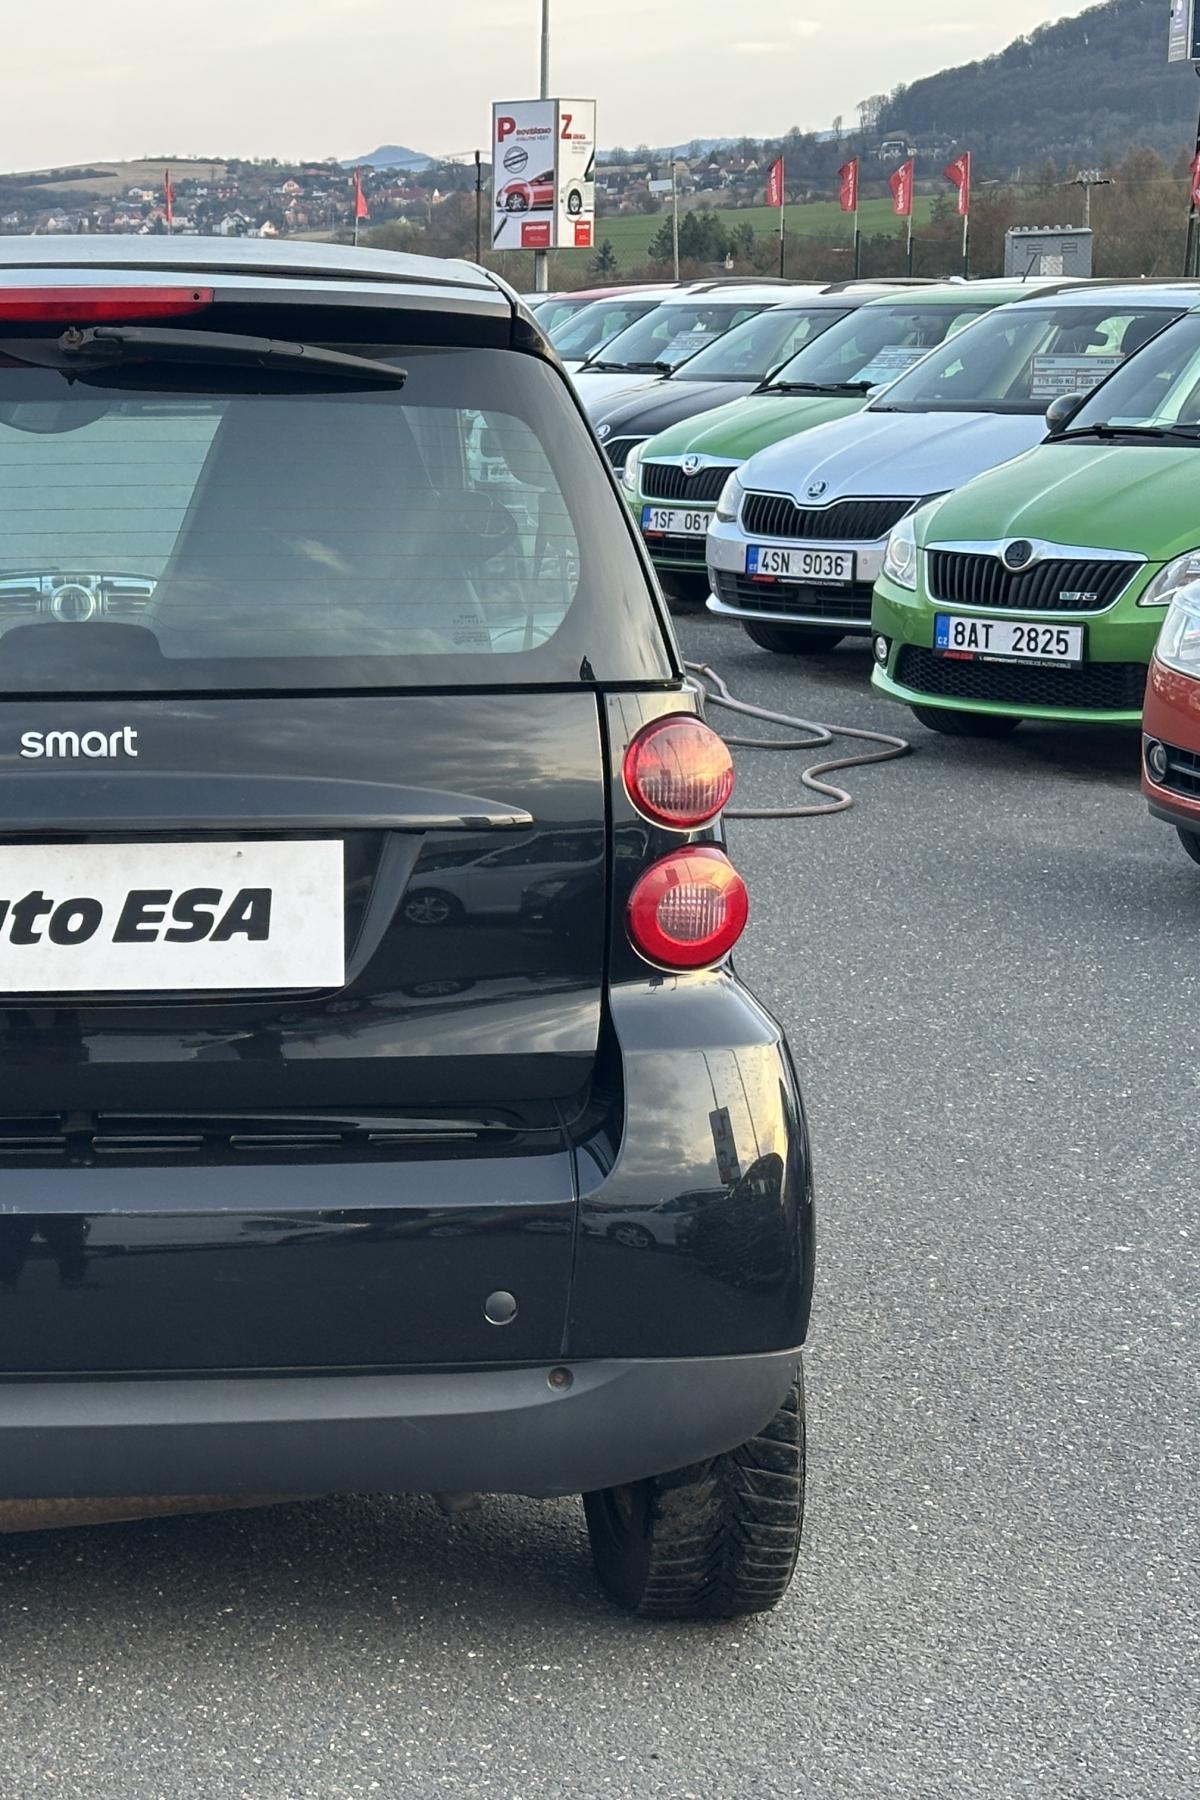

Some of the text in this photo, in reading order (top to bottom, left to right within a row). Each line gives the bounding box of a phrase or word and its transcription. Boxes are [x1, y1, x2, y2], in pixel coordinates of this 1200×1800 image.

[653, 511, 675, 528] 1SF
[761, 551, 844, 576] 4SN 9036
[937, 636, 948, 645] CZ
[954, 621, 1070, 655] 8AT 2825
[20, 726, 138, 758] smart
[112, 888, 272, 943] ESA
